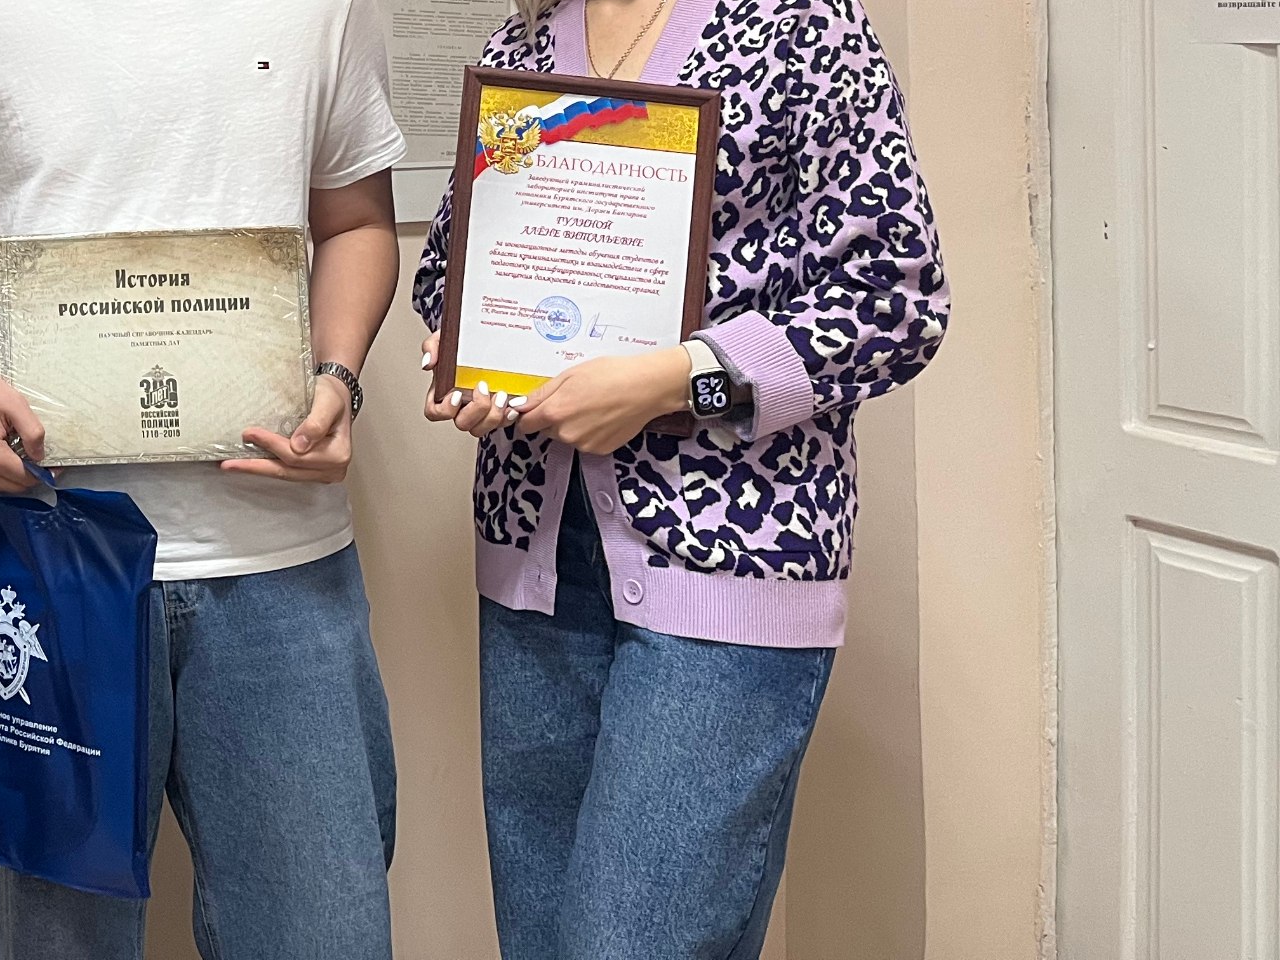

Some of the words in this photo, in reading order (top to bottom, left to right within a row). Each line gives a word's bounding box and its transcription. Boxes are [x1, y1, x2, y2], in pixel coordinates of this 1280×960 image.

[536, 155, 688, 182] БЛАГОДАРНОСТЬ
[115, 268, 189, 288] История
[141, 418, 180, 429] ПОЛИЦИИ
[11, 715, 57, 733] управление
[9, 725, 54, 744] Российской
[55, 737, 101, 756] Федерации
[18, 739, 50, 755] Бурятия
